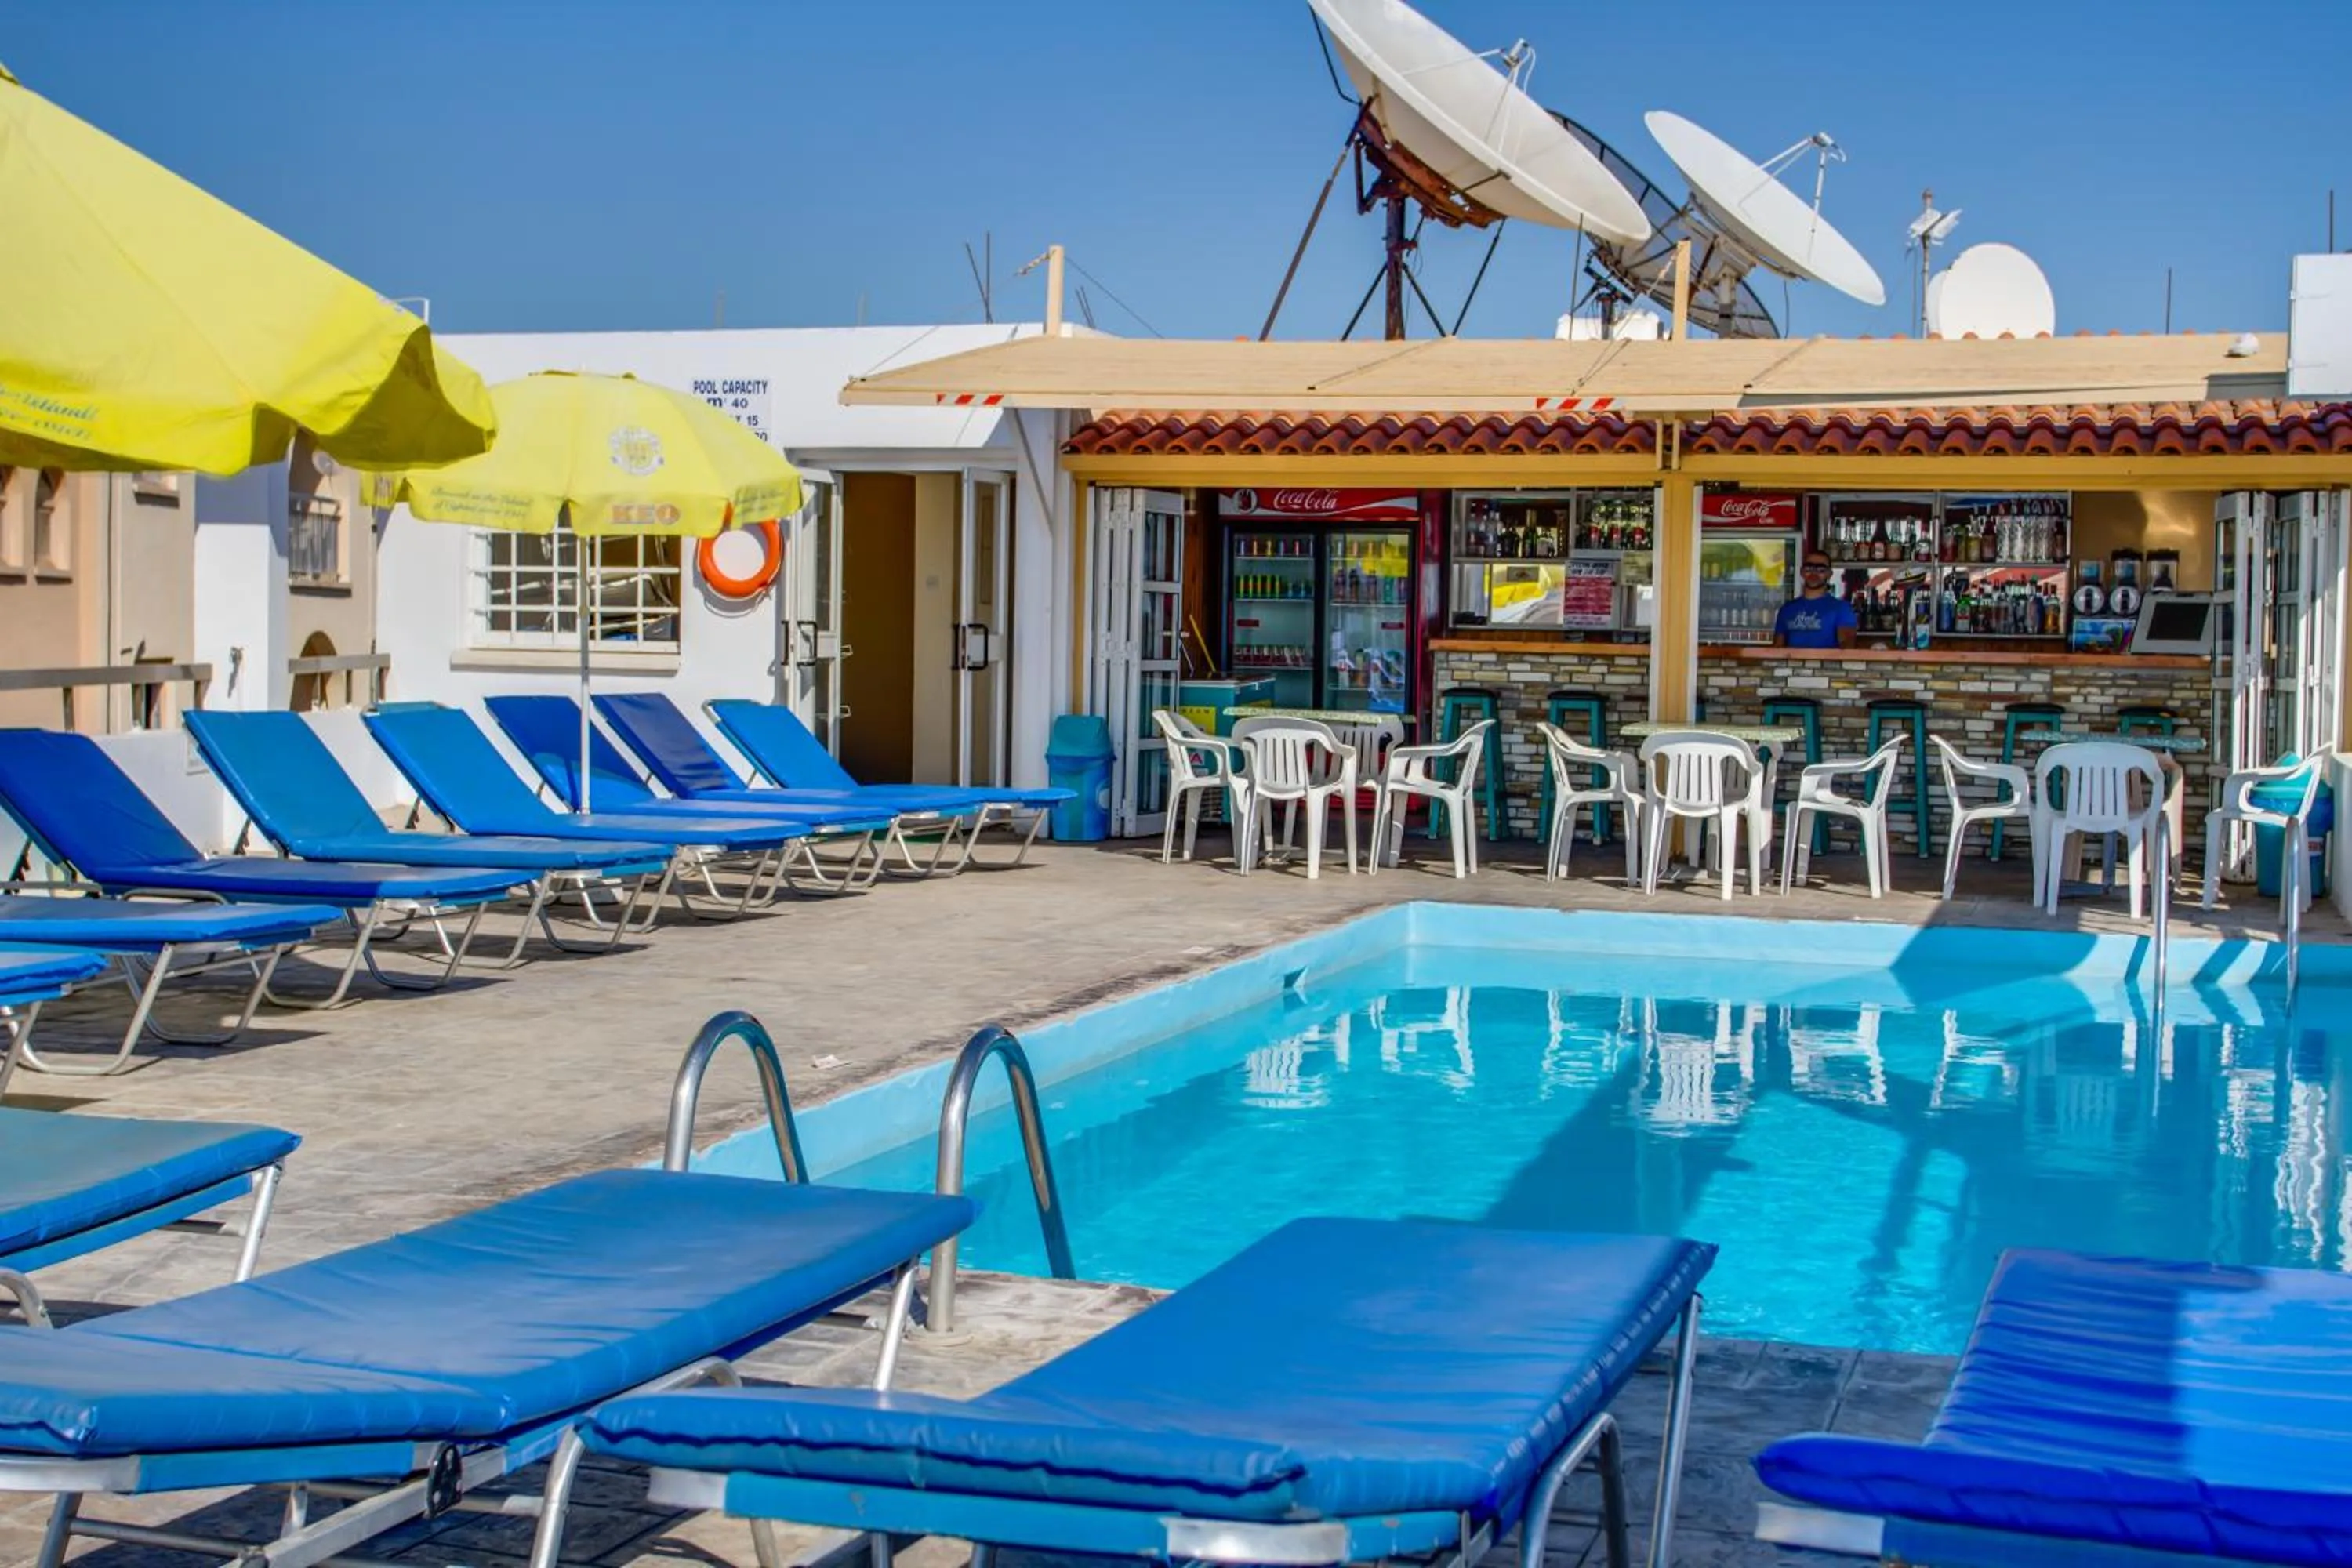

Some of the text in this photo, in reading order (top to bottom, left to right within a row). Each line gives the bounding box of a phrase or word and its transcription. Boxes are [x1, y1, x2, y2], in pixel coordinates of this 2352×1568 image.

[693, 380, 768, 394] POOL CAPACITY
[731, 398, 748, 408] 40
[747, 415, 759, 426] 15
